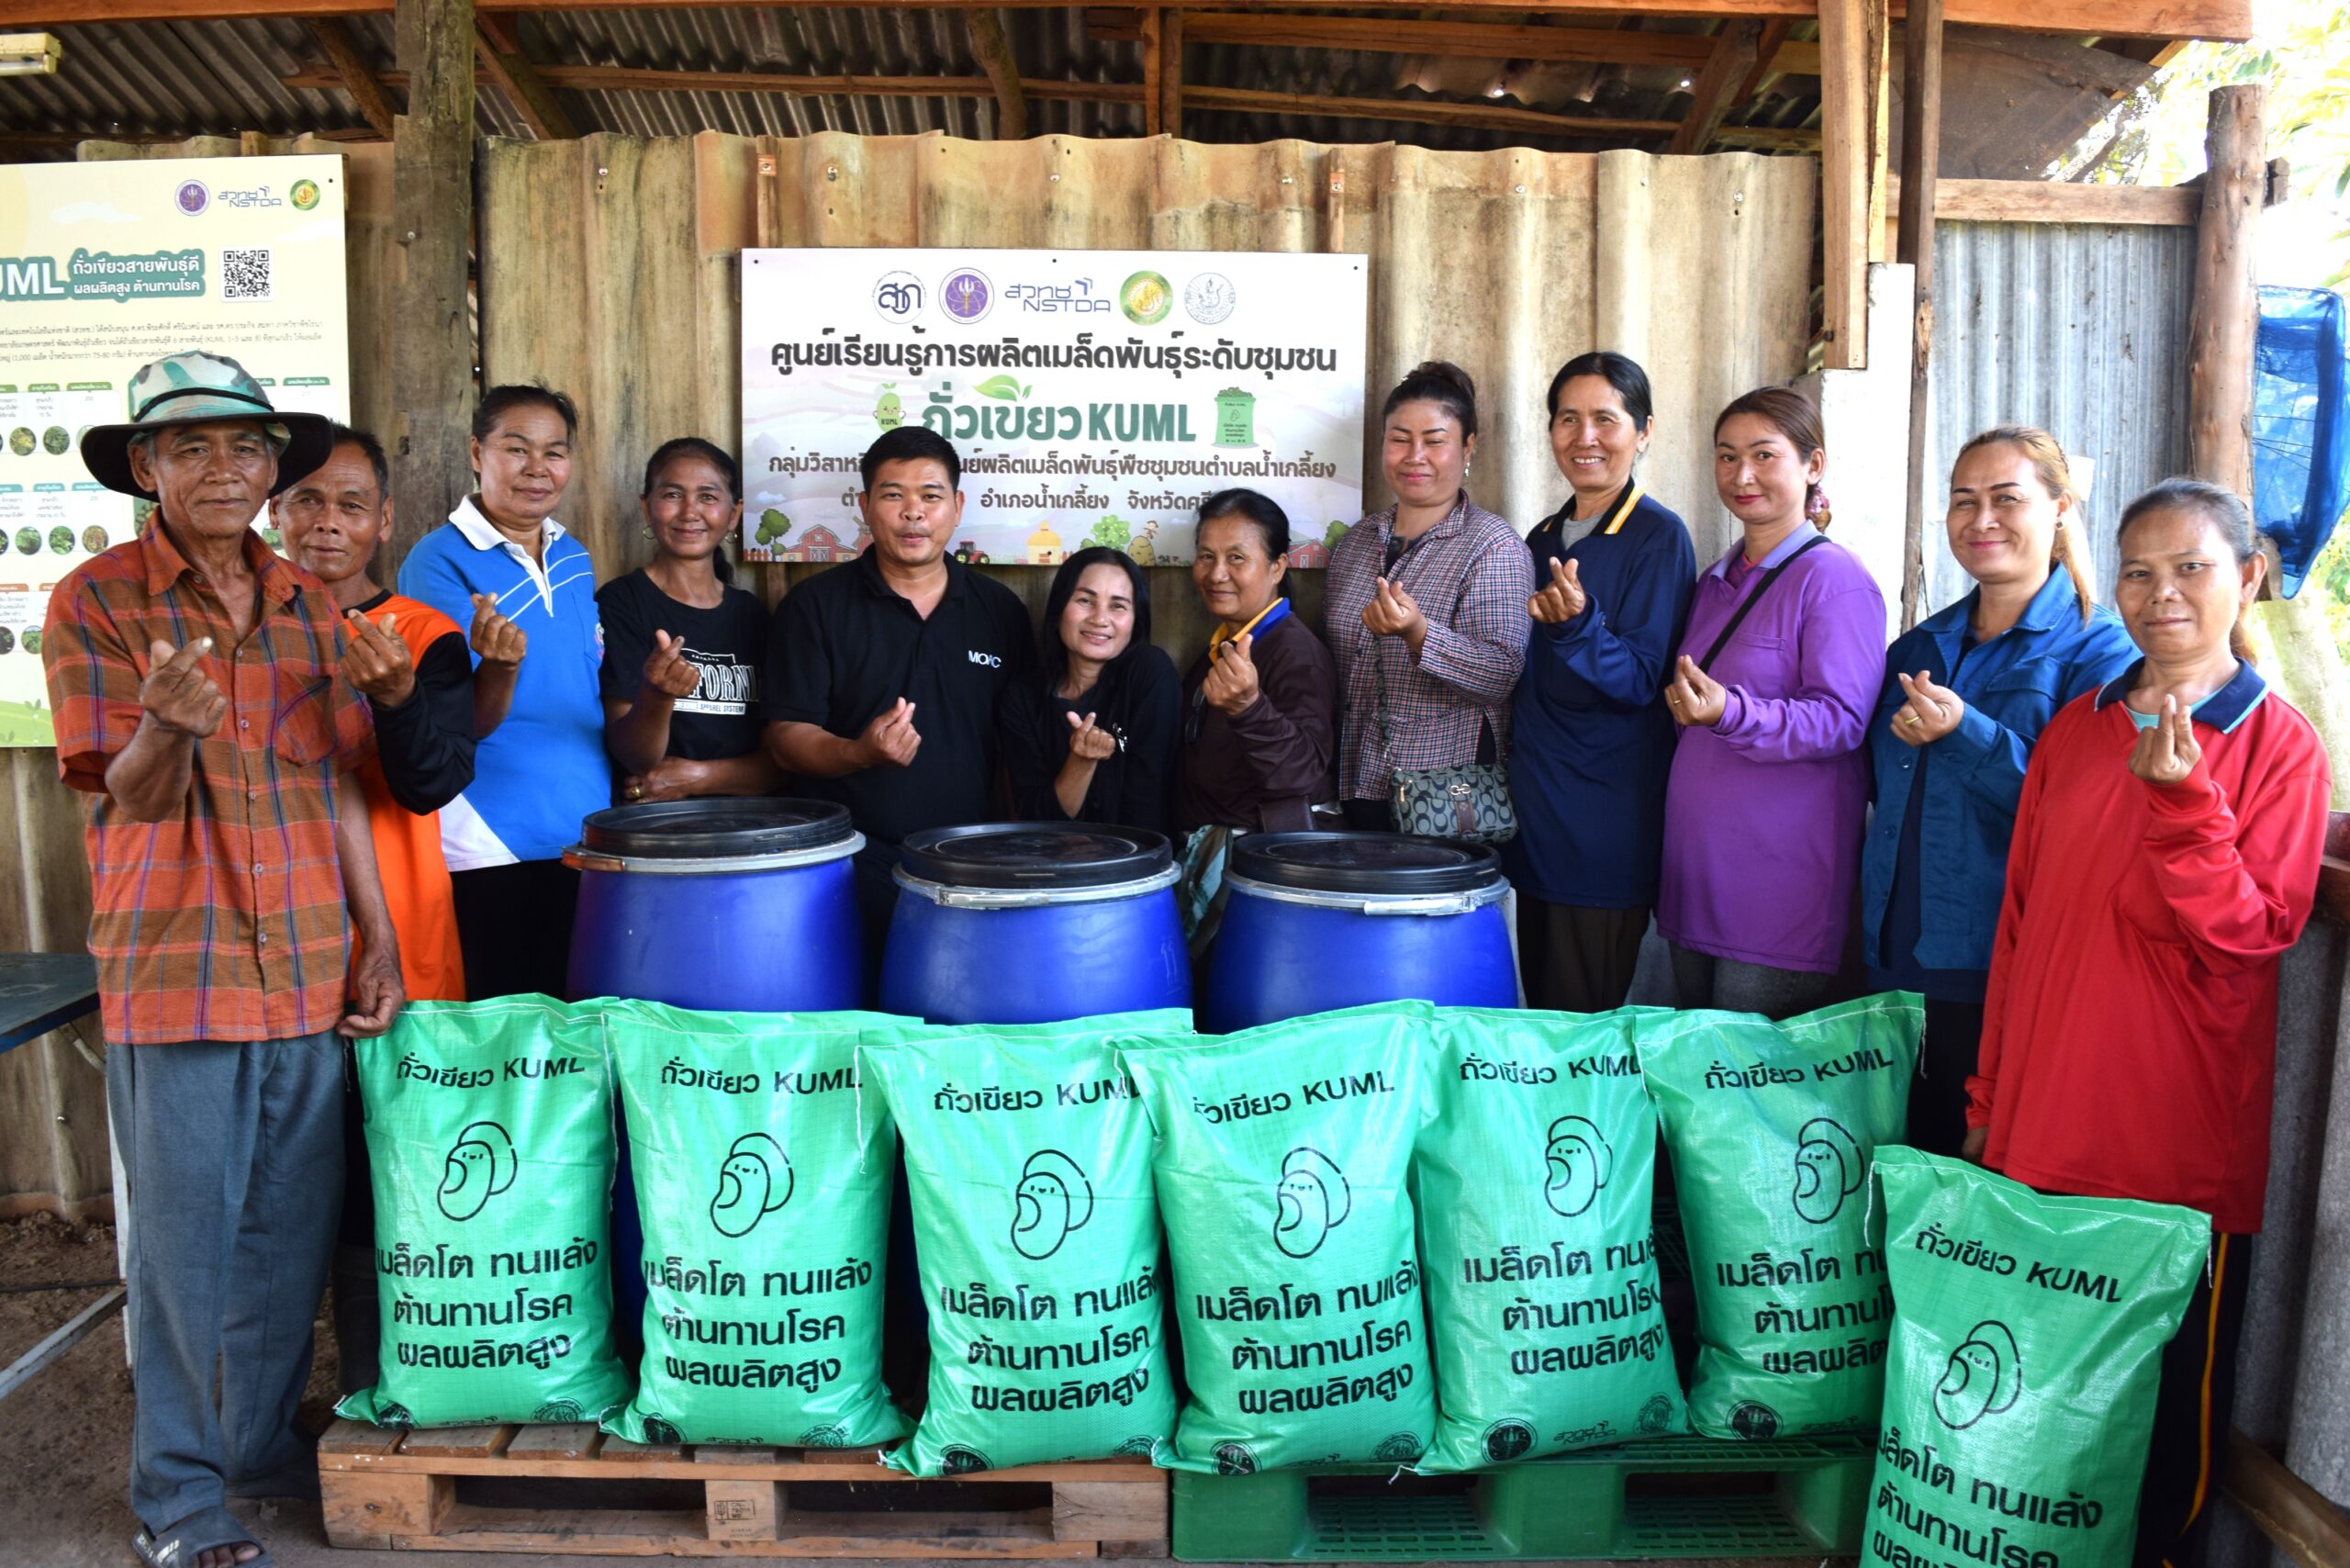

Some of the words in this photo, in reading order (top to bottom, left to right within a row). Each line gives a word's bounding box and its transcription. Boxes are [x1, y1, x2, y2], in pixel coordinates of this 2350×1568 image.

[229, 198, 282, 207] NSTDA
[0, 263, 64, 296] ML
[73, 254, 199, 276] ถั่วเขียวสายพันธุ์ดี
[74, 281, 130, 297] ผลผลิตสูง
[133, 277, 200, 293] ต้านทานโรค
[1024, 298, 1111, 313] NSTDA
[771, 327, 1337, 380] ศูนย์เรียนรู้การผลิตเมล็ดพันธุ์ระดับชุมชน
[1090, 402, 1197, 443] KUML
[980, 483, 1110, 510] อำเภอน้ำเกลี้ยง
[397, 1052, 494, 1088] ถั่วเขียว
[504, 1057, 585, 1081] KUML
[661, 1057, 760, 1094] ถั่วเขียว
[774, 1068, 863, 1094] KUML
[1460, 1053, 1557, 1085] ถั่วเขียว
[1705, 1060, 1805, 1090] ถั่วเขียว
[1812, 1048, 1894, 1081] KUML
[934, 1082, 1043, 1114] ถั่วเขียว
[1057, 1077, 1140, 1105] KUML
[1192, 1092, 1292, 1124] ั่วเขียว
[1302, 1070, 1394, 1105] KUML
[377, 1242, 473, 1278] เมล็ดโต
[490, 1237, 598, 1277] ทนแล้ง
[644, 1256, 745, 1296] เมล็ดโต
[764, 1257, 872, 1296] ทนแล้ง
[1464, 1241, 1593, 1283] เมล็ดโต
[1717, 1248, 1841, 1287] เมล็ดโต
[1916, 1222, 2017, 1276] ถั่วเขียว
[2026, 1260, 2122, 1304] KUML
[394, 1287, 572, 1327] ต้านทานโรค
[941, 1282, 1057, 1321] เมล็ดโต
[1196, 1283, 1322, 1321] เมล็ดโต
[662, 1308, 845, 1346] ต้านทานโรค
[1232, 1319, 1412, 1371] ต้านทานโรค
[397, 1334, 571, 1370] ผลผลิตสูง
[968, 1325, 1149, 1371] ต้านทานโรค
[1511, 1324, 1664, 1375] ผลผลิตสูง
[666, 1356, 841, 1394] ผลผลิตสูง
[971, 1368, 1149, 1412] ผลผลิตสูง
[1238, 1363, 1414, 1415] ผลผลิตสูง
[1970, 1477, 2103, 1529] ทนแล้ง
